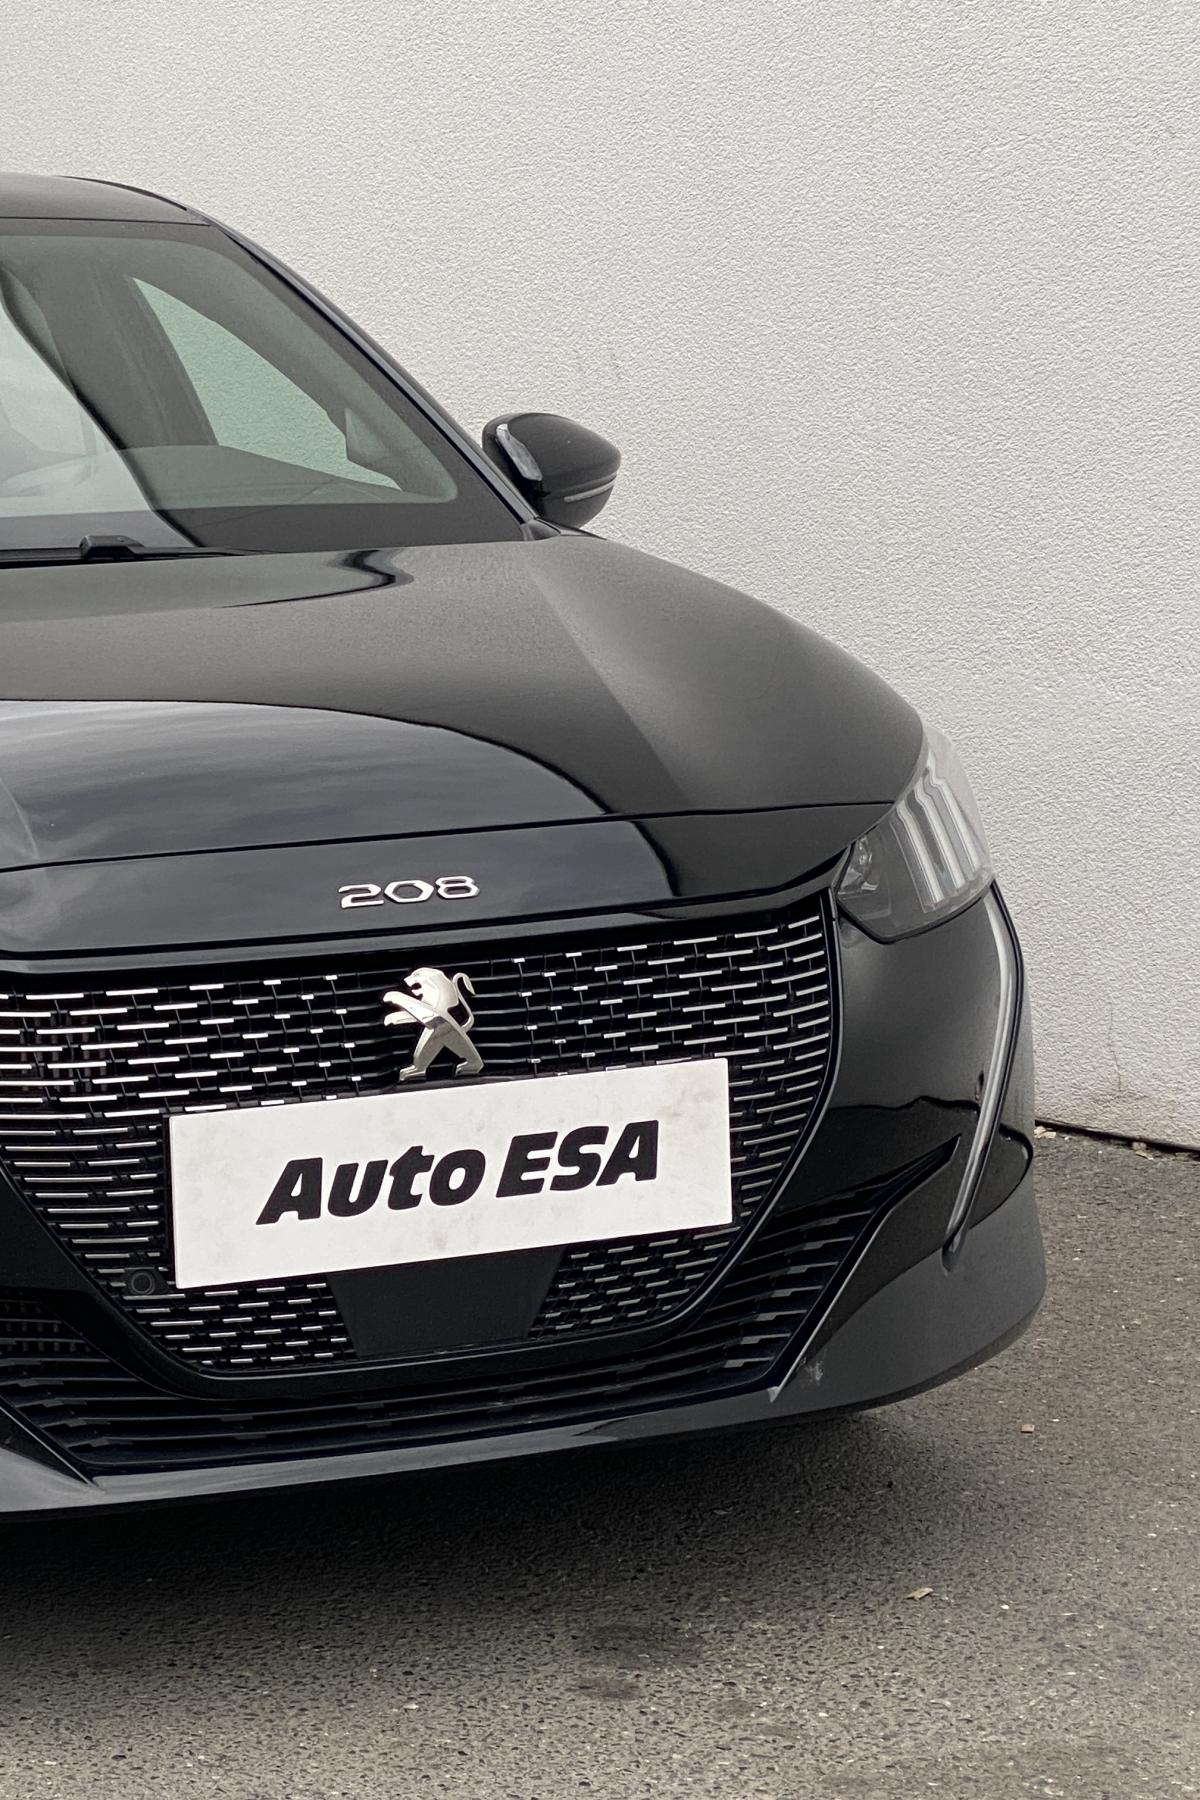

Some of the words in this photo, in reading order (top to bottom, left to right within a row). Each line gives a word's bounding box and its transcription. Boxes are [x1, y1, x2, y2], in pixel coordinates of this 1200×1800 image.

[338, 875, 481, 909] 208
[255, 1145, 486, 1226] Auto
[495, 1119, 659, 1198] ESA
